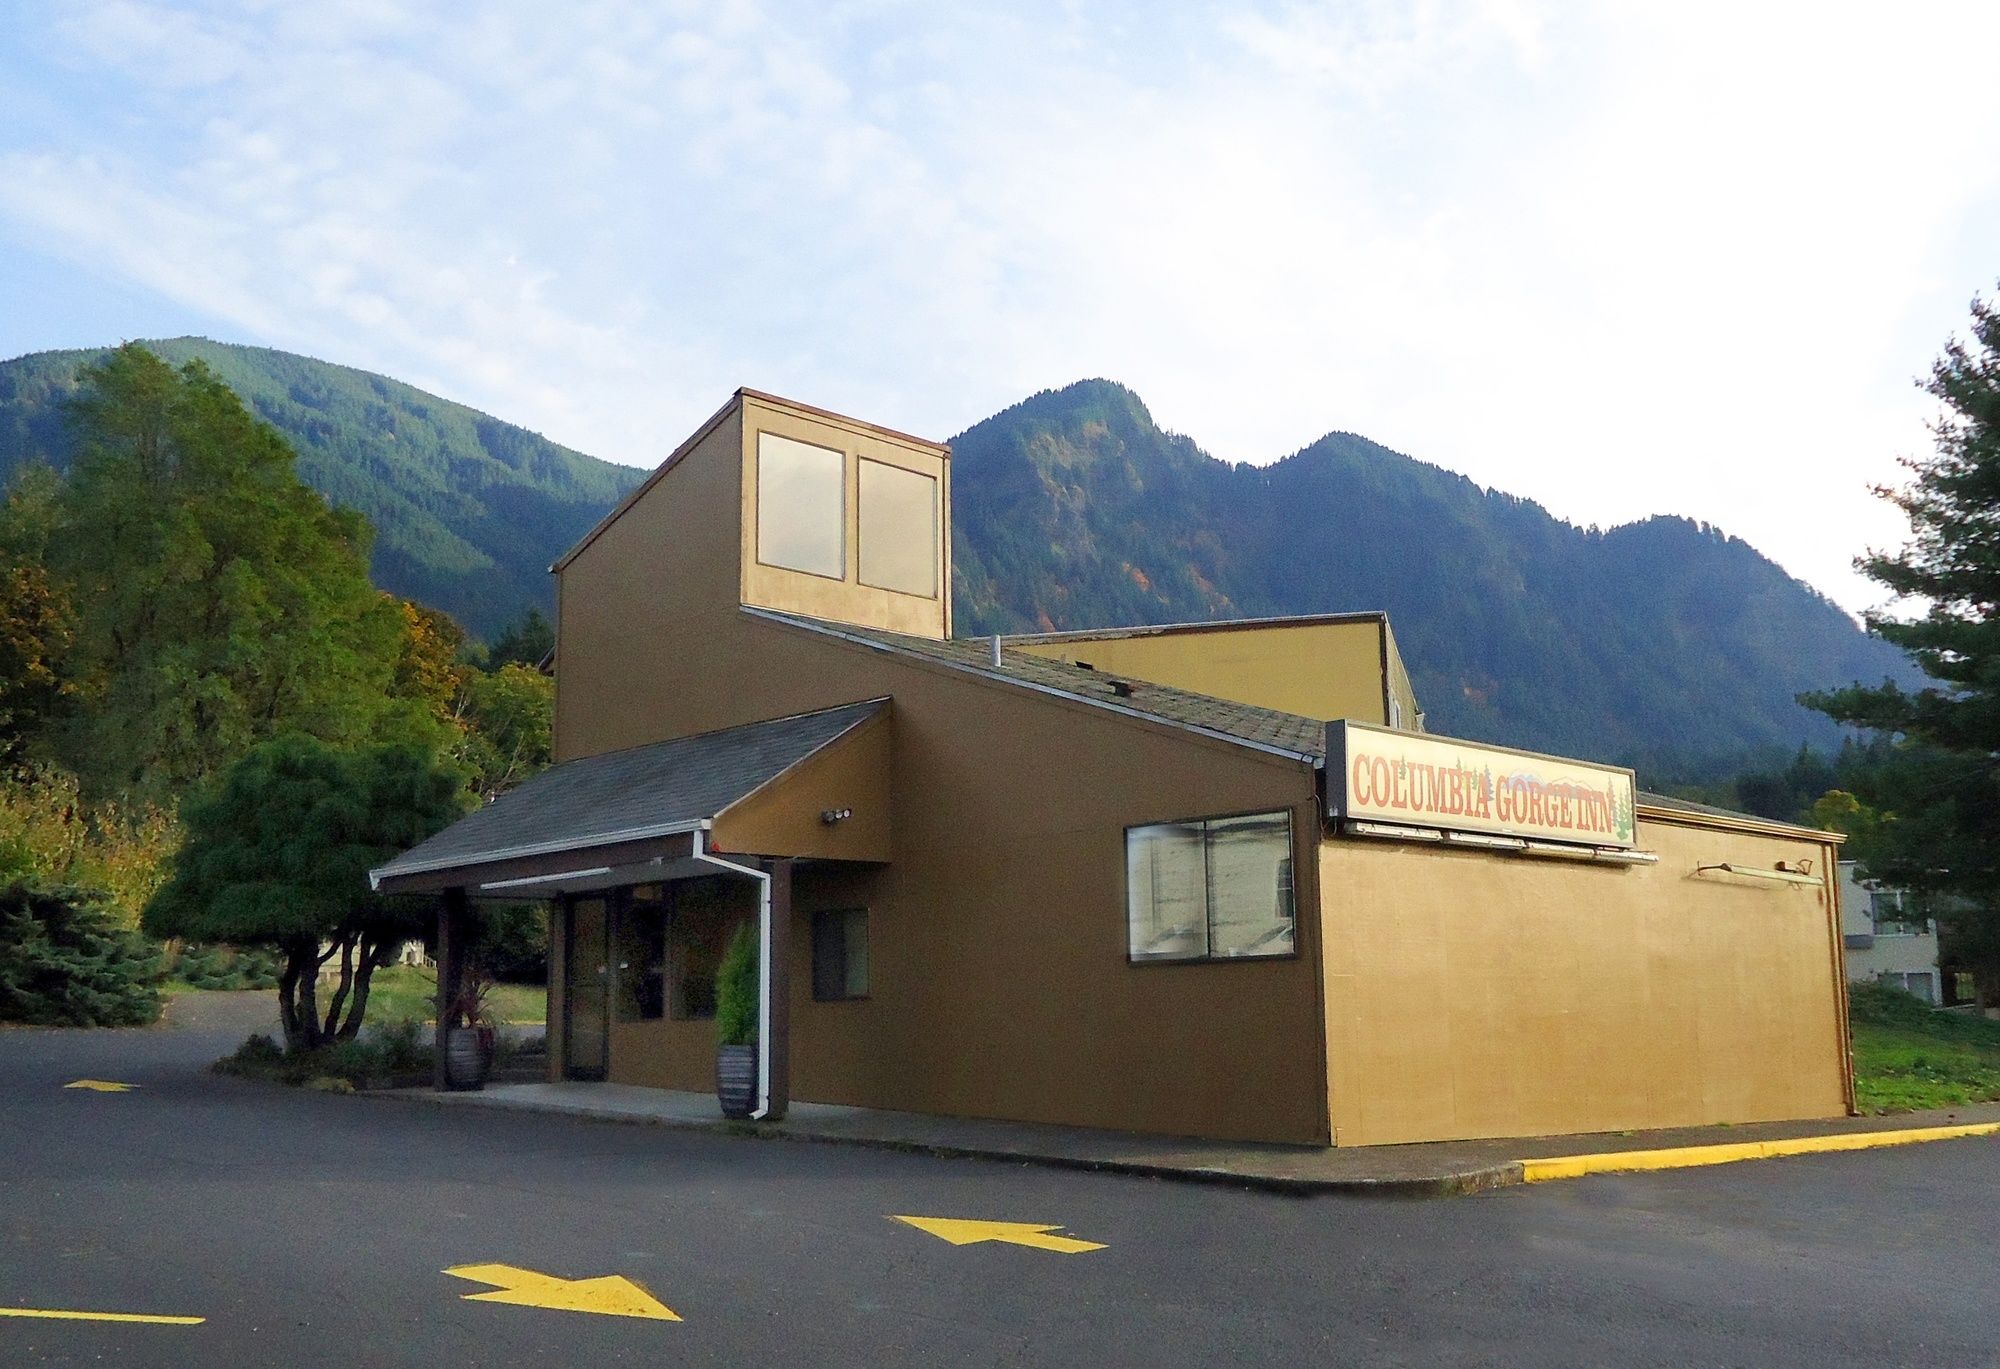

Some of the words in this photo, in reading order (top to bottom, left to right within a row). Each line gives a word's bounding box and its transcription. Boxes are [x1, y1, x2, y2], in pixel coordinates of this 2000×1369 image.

[1353, 753, 1490, 818] COLUMBIA
[1496, 775, 1572, 828] GORGE
[1576, 790, 1613, 833] INN
